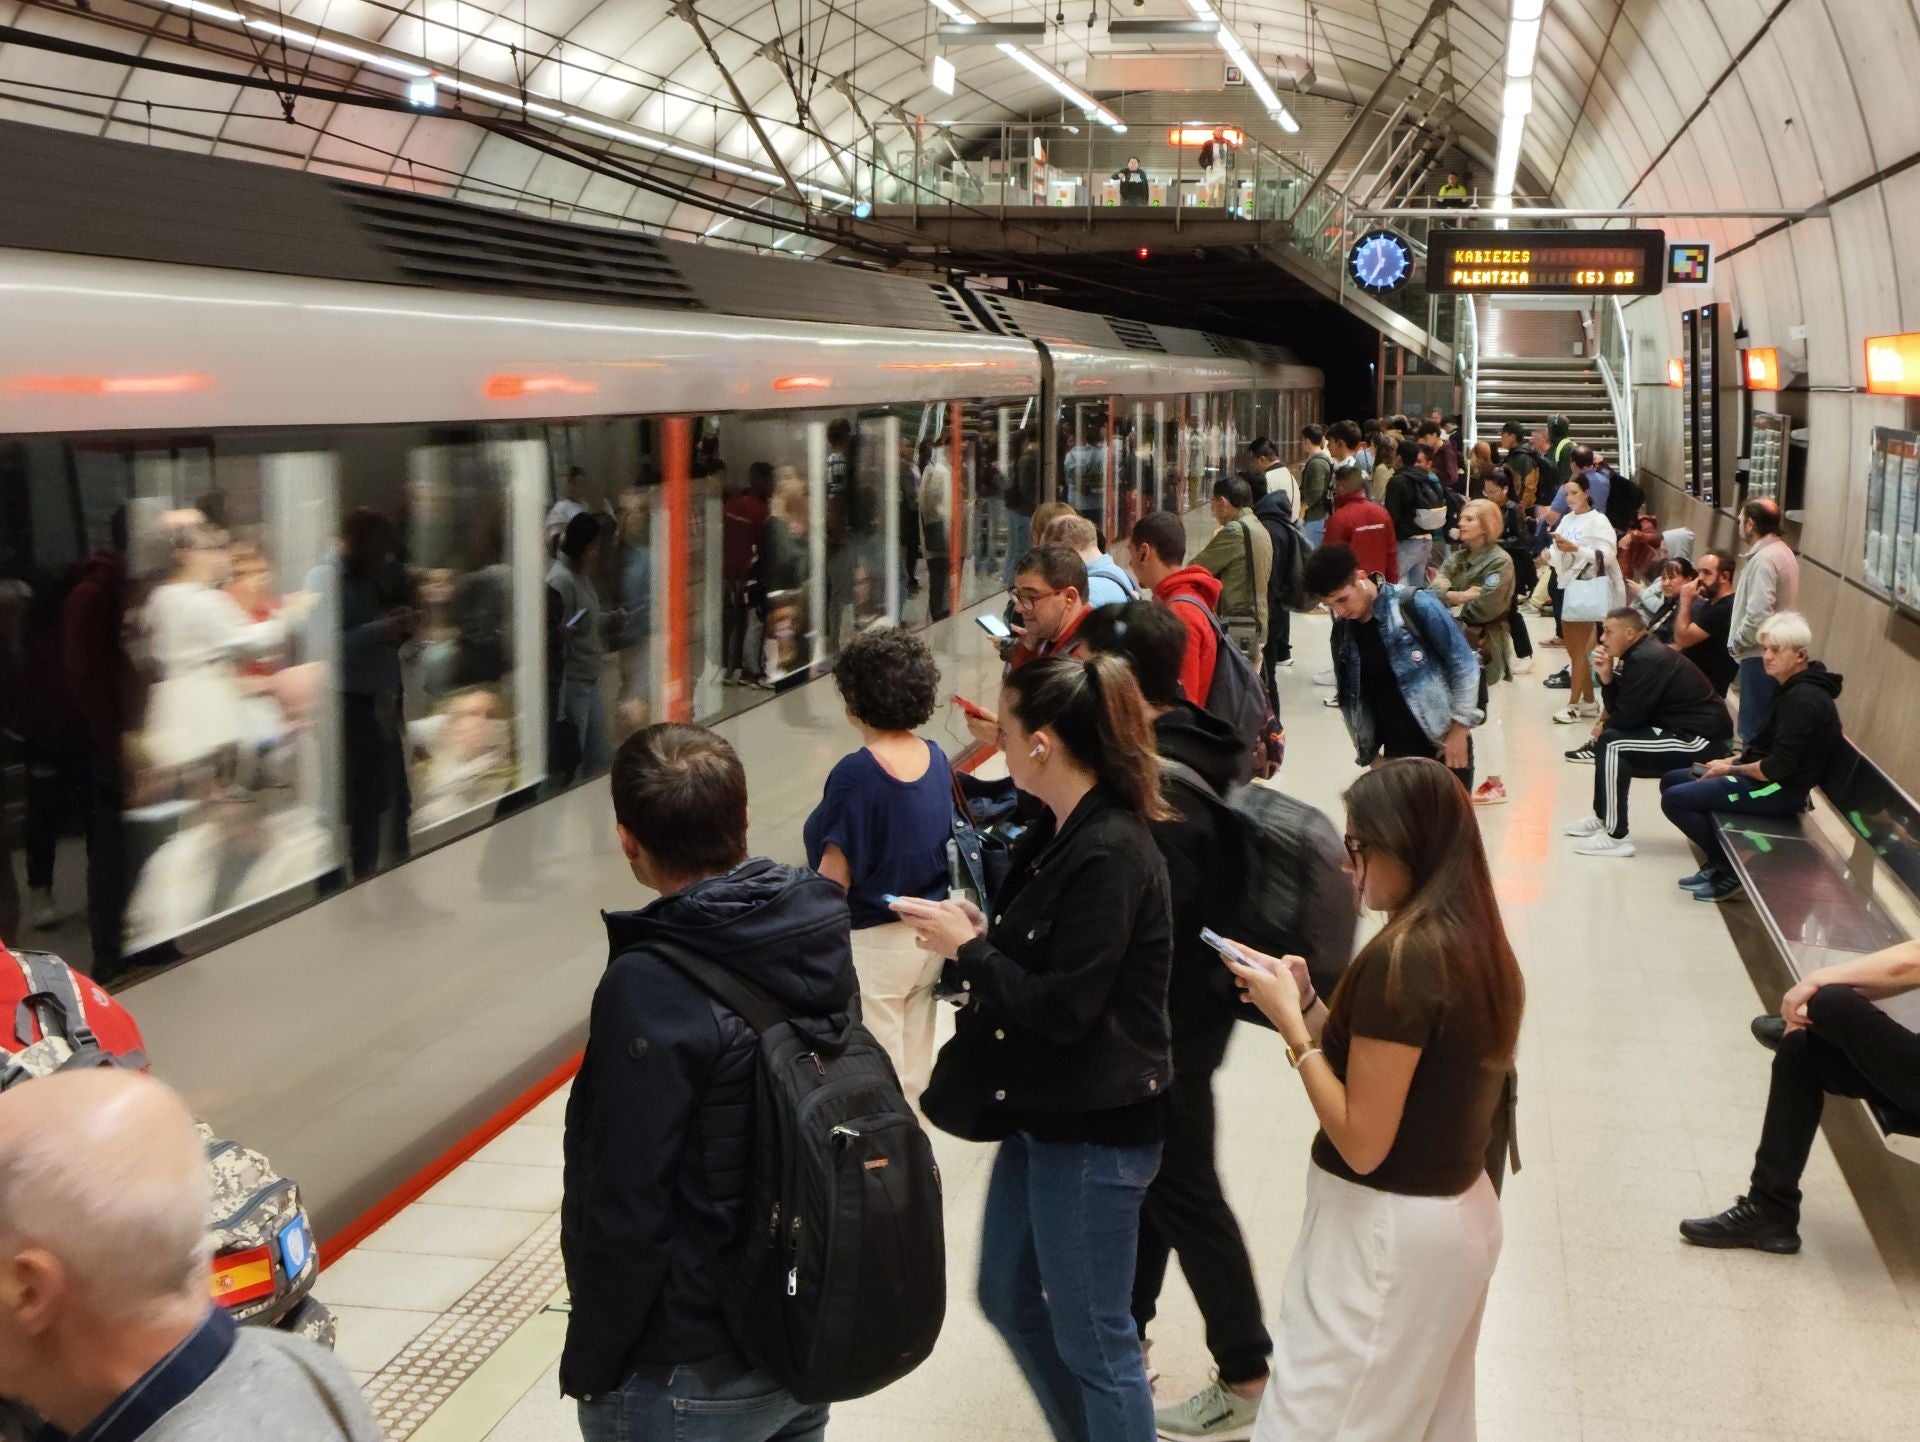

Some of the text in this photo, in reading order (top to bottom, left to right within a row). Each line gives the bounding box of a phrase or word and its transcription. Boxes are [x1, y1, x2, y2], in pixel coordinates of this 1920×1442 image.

[1455, 250, 1530, 263] KABIEZES
[1453, 271, 1529, 284] PLENTZIA
[1577, 271, 1604, 284] (5)
